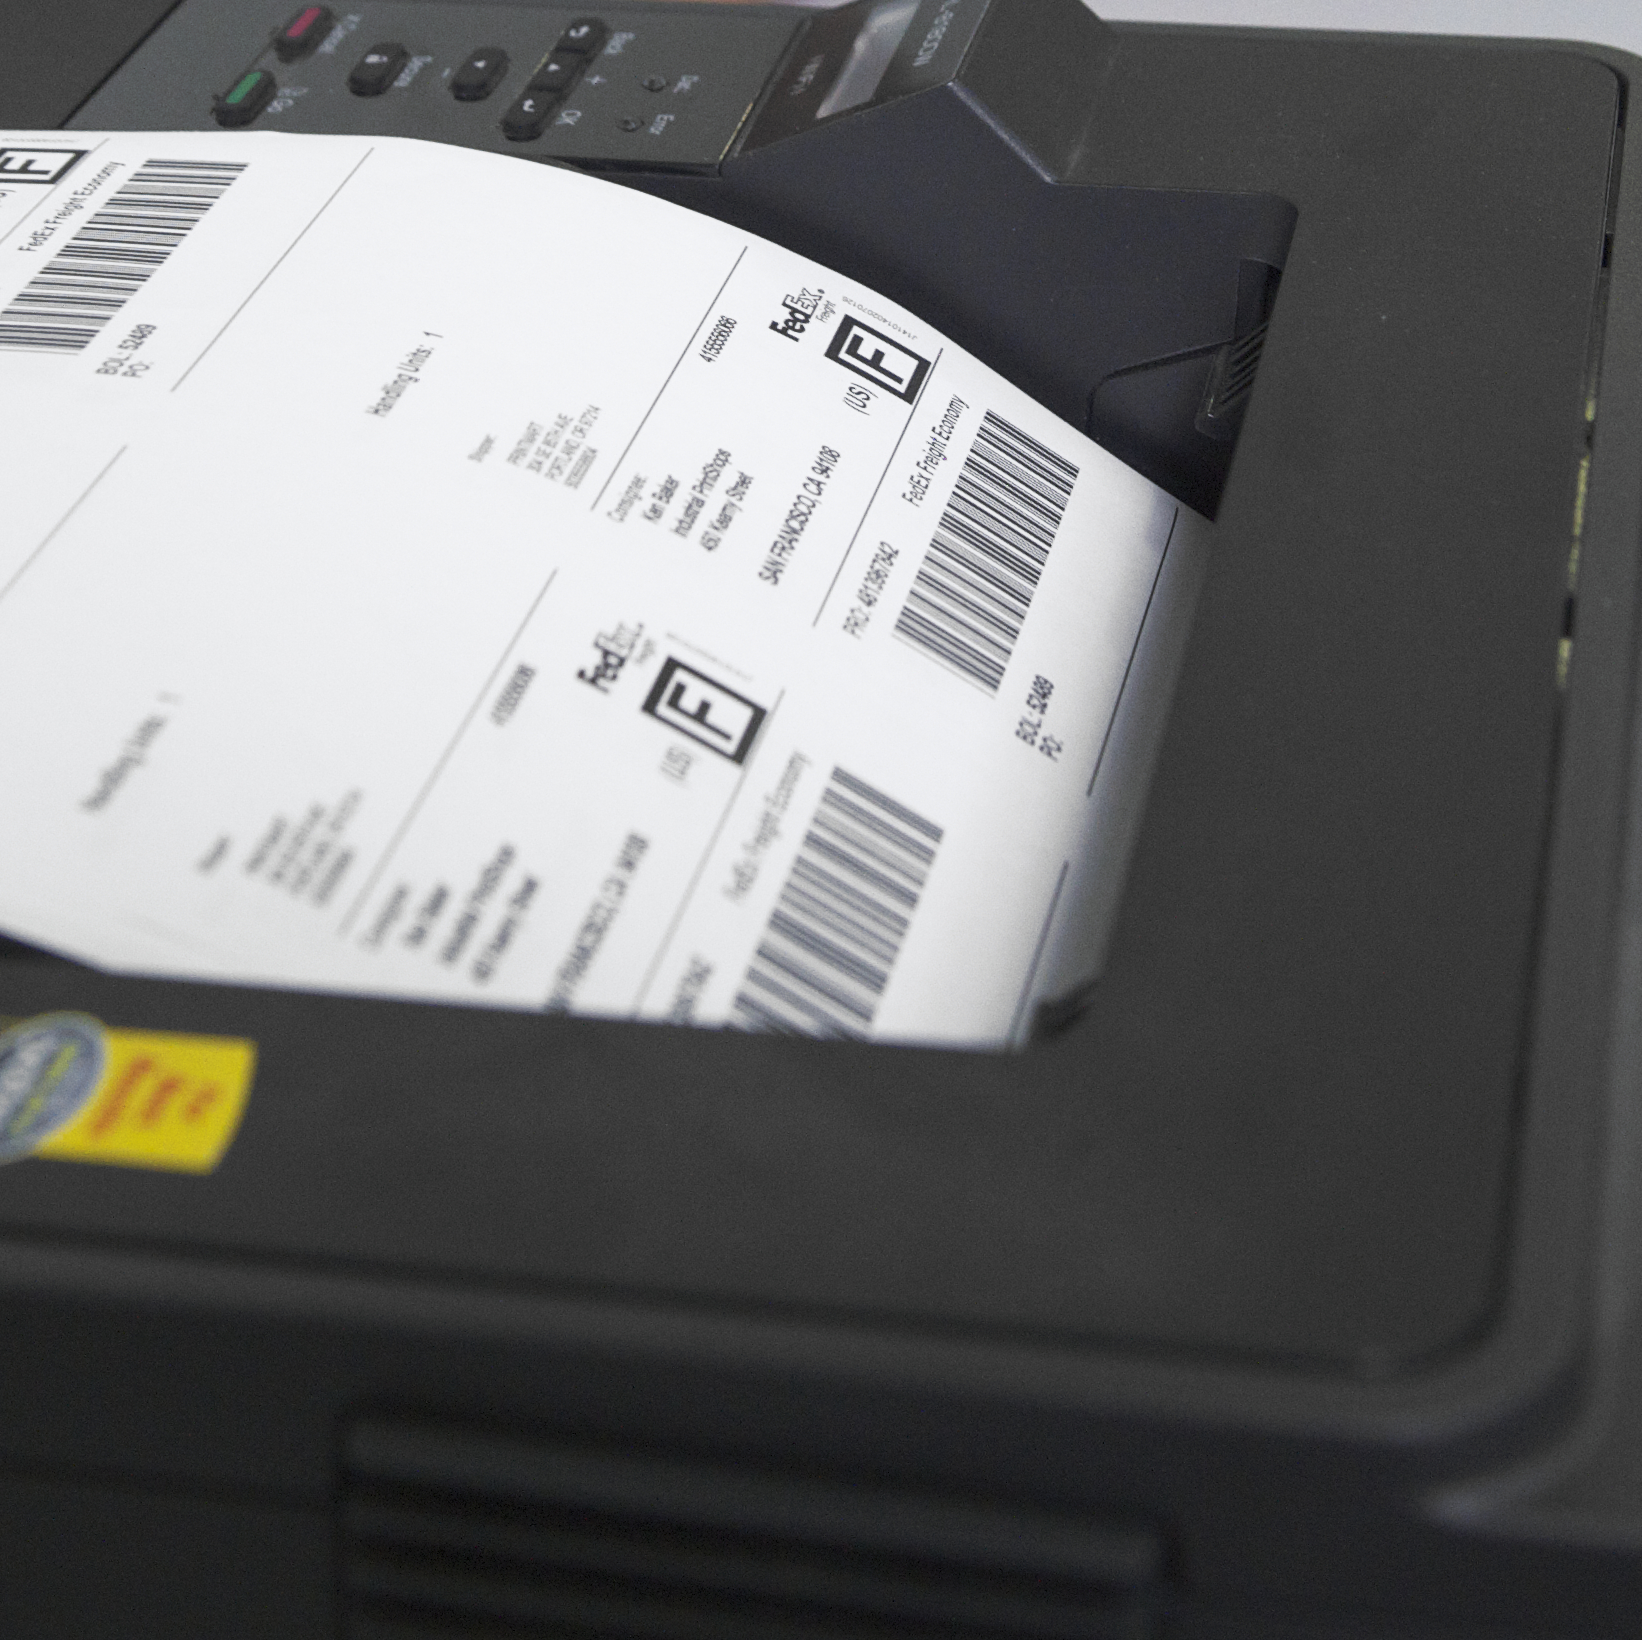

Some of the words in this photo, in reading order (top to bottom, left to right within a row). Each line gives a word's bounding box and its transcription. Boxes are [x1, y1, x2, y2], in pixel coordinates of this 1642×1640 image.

[555, 109, 583, 126] OK
[17, 226, 57, 251] FedEx
[44, 197, 86, 224] Freight
[72, 161, 126, 196] Economy
[769, 288, 825, 342] FedEx
[815, 300, 836, 323] Freight
[95, 353, 132, 375] BOL:
[117, 324, 157, 351] 52489
[844, 332, 905, 385] F
[121, 361, 150, 378] PO:
[366, 373, 420, 417] Handling
[397, 345, 434, 373] Units:
[844, 383, 877, 415] (US)
[931, 395, 970, 441] Economy
[811, 445, 841, 479] 94108
[916, 436, 947, 475] Freight
[651, 475, 679, 505] Baker
[672, 494, 706, 538] Industrial
[691, 448, 731, 497] PrintShops
[725, 471, 753, 502] Street
[802, 476, 826, 496] CA
[901, 472, 931, 507] FedEx
[642, 503, 665, 523] Ken
[769, 494, 820, 561] FRANCISCO,
[758, 556, 786, 586] SAN
[842, 607, 870, 639] PRO:
[857, 541, 899, 608] 4813967842
[665, 682, 734, 742] F
[1026, 674, 1055, 716] 52489
[1015, 712, 1046, 747] BOL:
[1032, 735, 1064, 763] PO:
